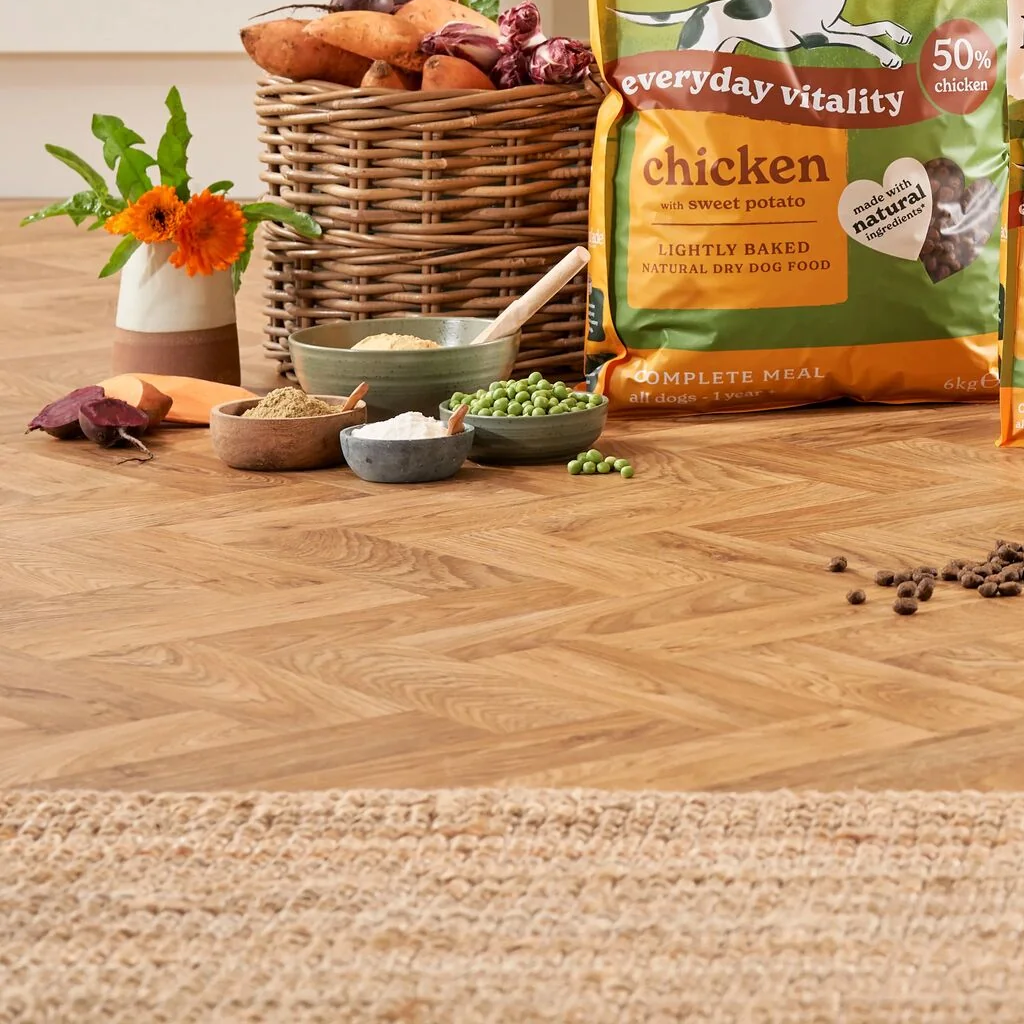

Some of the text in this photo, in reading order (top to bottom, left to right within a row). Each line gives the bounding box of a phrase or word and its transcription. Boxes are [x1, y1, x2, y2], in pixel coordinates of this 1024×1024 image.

[932, 37, 992, 71] 50%
[621, 66, 905, 117] everyday vitality
[934, 77, 988, 94] chicken
[643, 144, 830, 187] chicken
[661, 194, 806, 213] with sweet potato
[852, 179, 913, 216] made with
[851, 184, 928, 234] natural
[658, 240, 811, 257] LIGHTLY BAKED
[641, 259, 831, 275] NATURAL DRY DOG FOOD
[634, 367, 825, 385] COMPLETE MEAL
[629, 391, 650, 403] all
[655, 392, 696, 404] dogs
